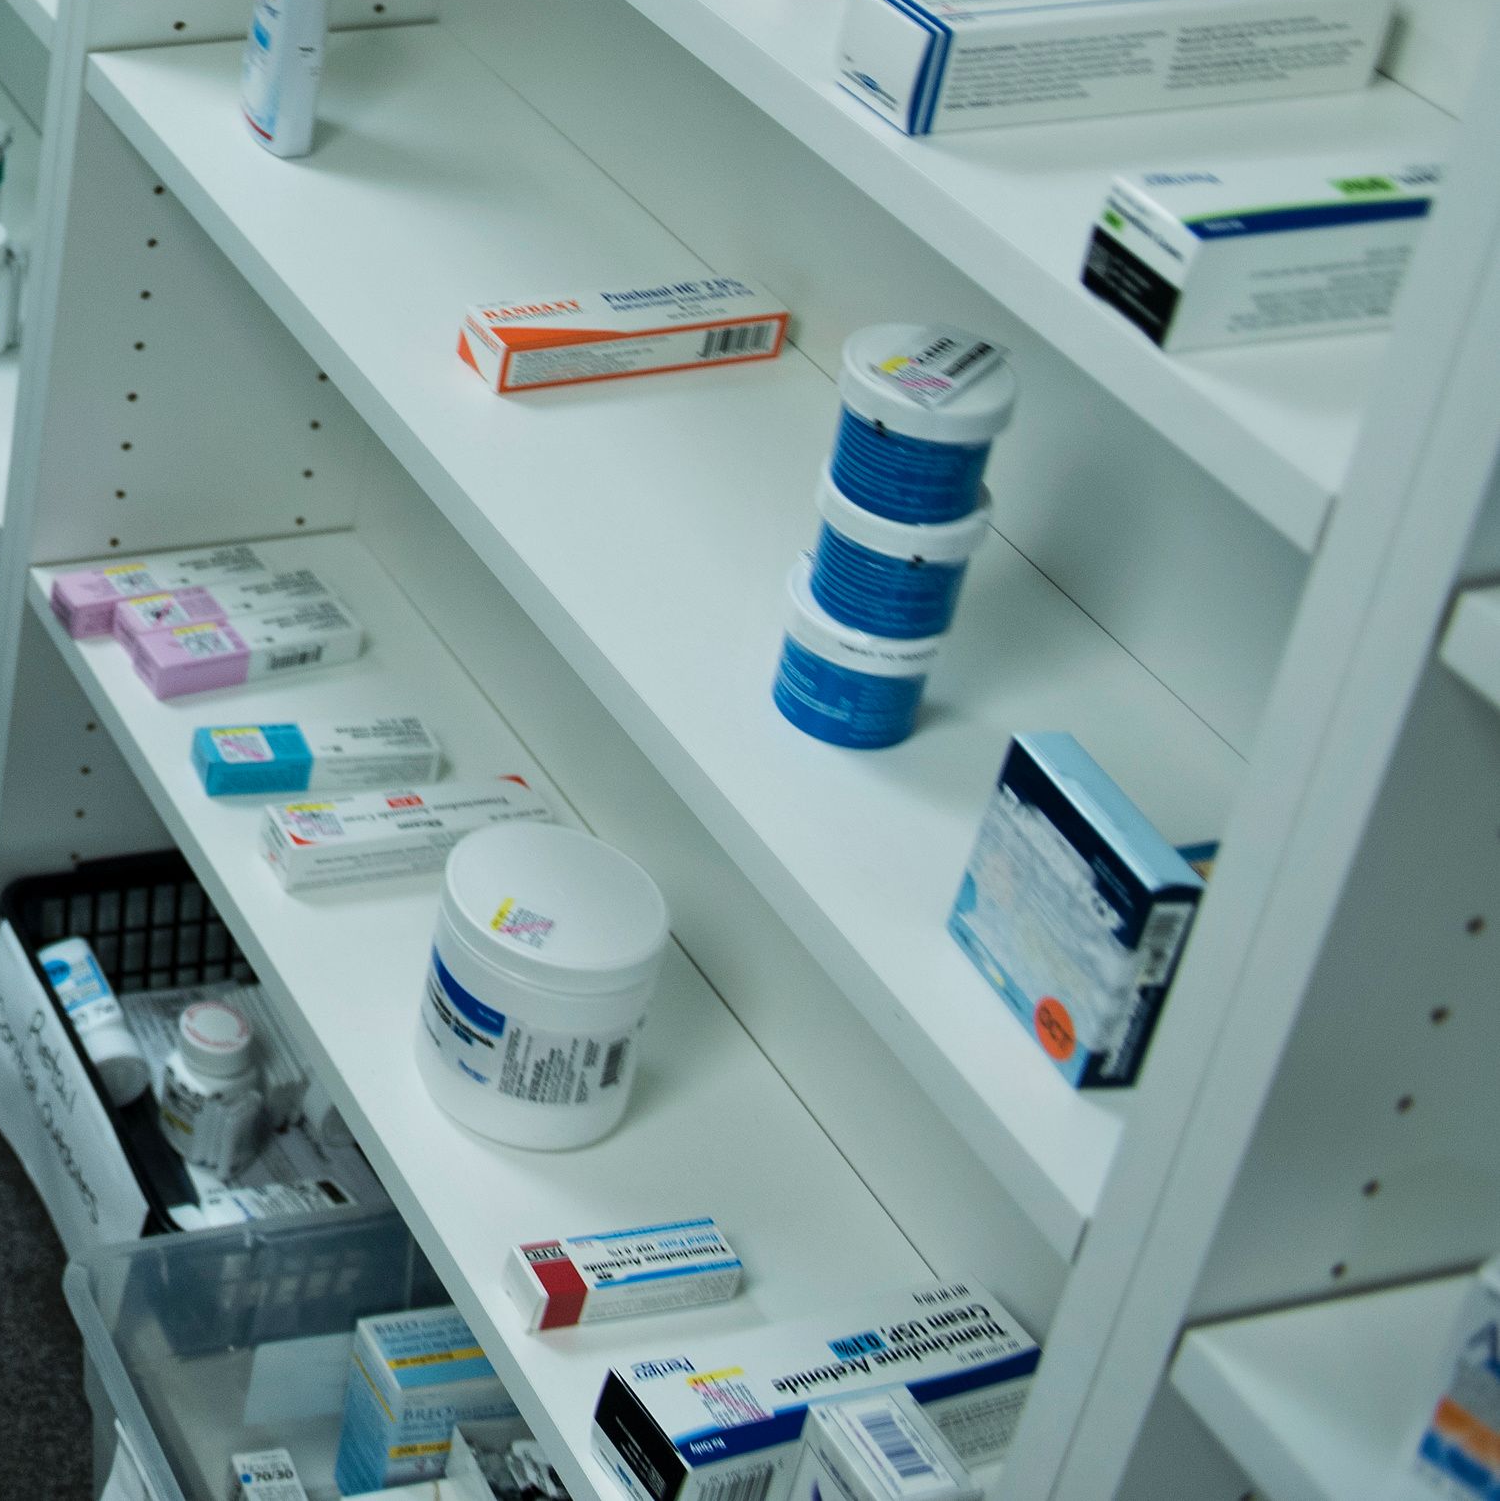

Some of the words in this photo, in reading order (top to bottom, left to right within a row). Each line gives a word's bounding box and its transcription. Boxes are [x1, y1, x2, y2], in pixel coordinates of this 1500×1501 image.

[482, 298, 580, 320] RANBAXY
[523, 1246, 570, 1262] TARO
[582, 1256, 642, 1273] Acetonide
[644, 1244, 728, 1263] Triamcinolone
[928, 1303, 991, 1331] Cream
[832, 1332, 882, 1357] 0.1%
[873, 1320, 1010, 1370] Triamcinolone
[880, 1320, 925, 1347] USP,
[630, 1355, 698, 1380] Perrigo
[770, 1353, 873, 1395] Acetonide
[689, 1439, 713, 1456] Only
[254, 1469, 294, 1482] 70/30
